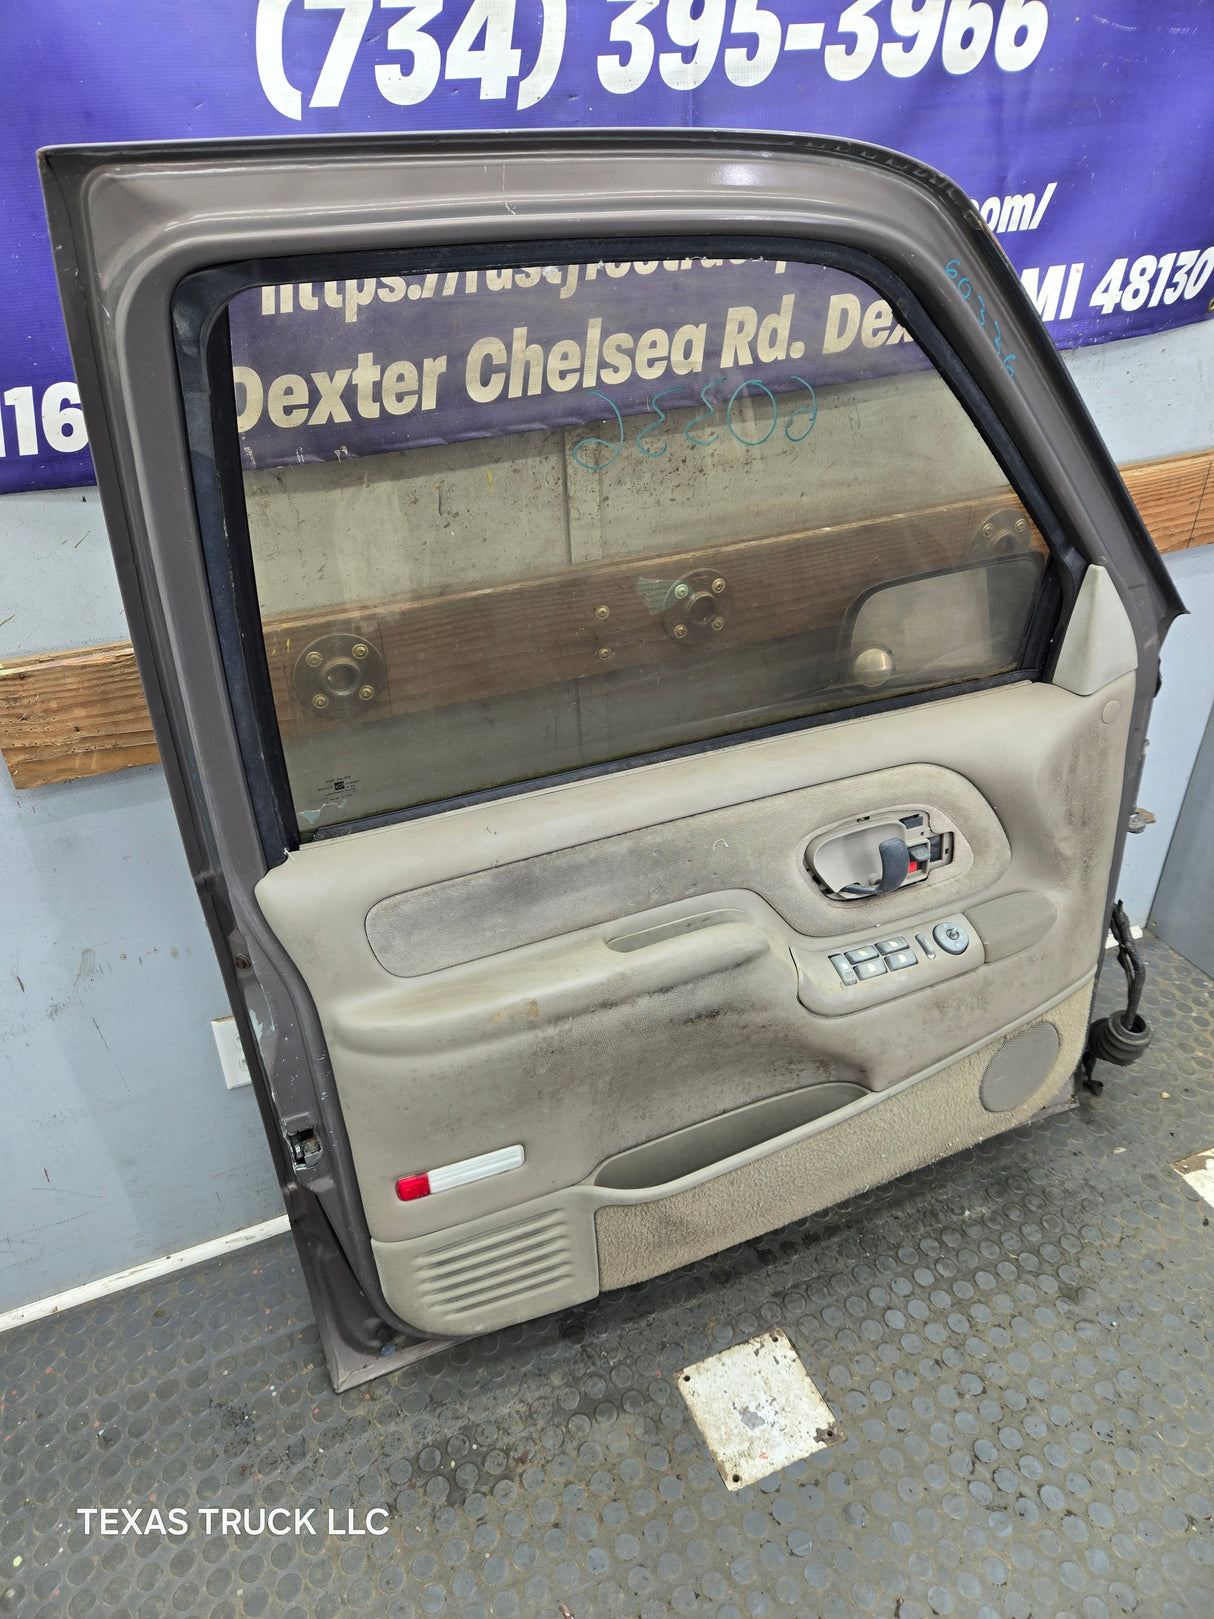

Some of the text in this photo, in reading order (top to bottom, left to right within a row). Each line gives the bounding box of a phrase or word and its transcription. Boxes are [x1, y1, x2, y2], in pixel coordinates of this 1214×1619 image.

[256, 0, 1049, 121] (734) 395-3966
[466, 317, 707, 403] Chelsea
[720, 293, 805, 368] Rd.
[1019, 262, 1086, 322] MI
[1089, 246, 1214, 315] 48130
